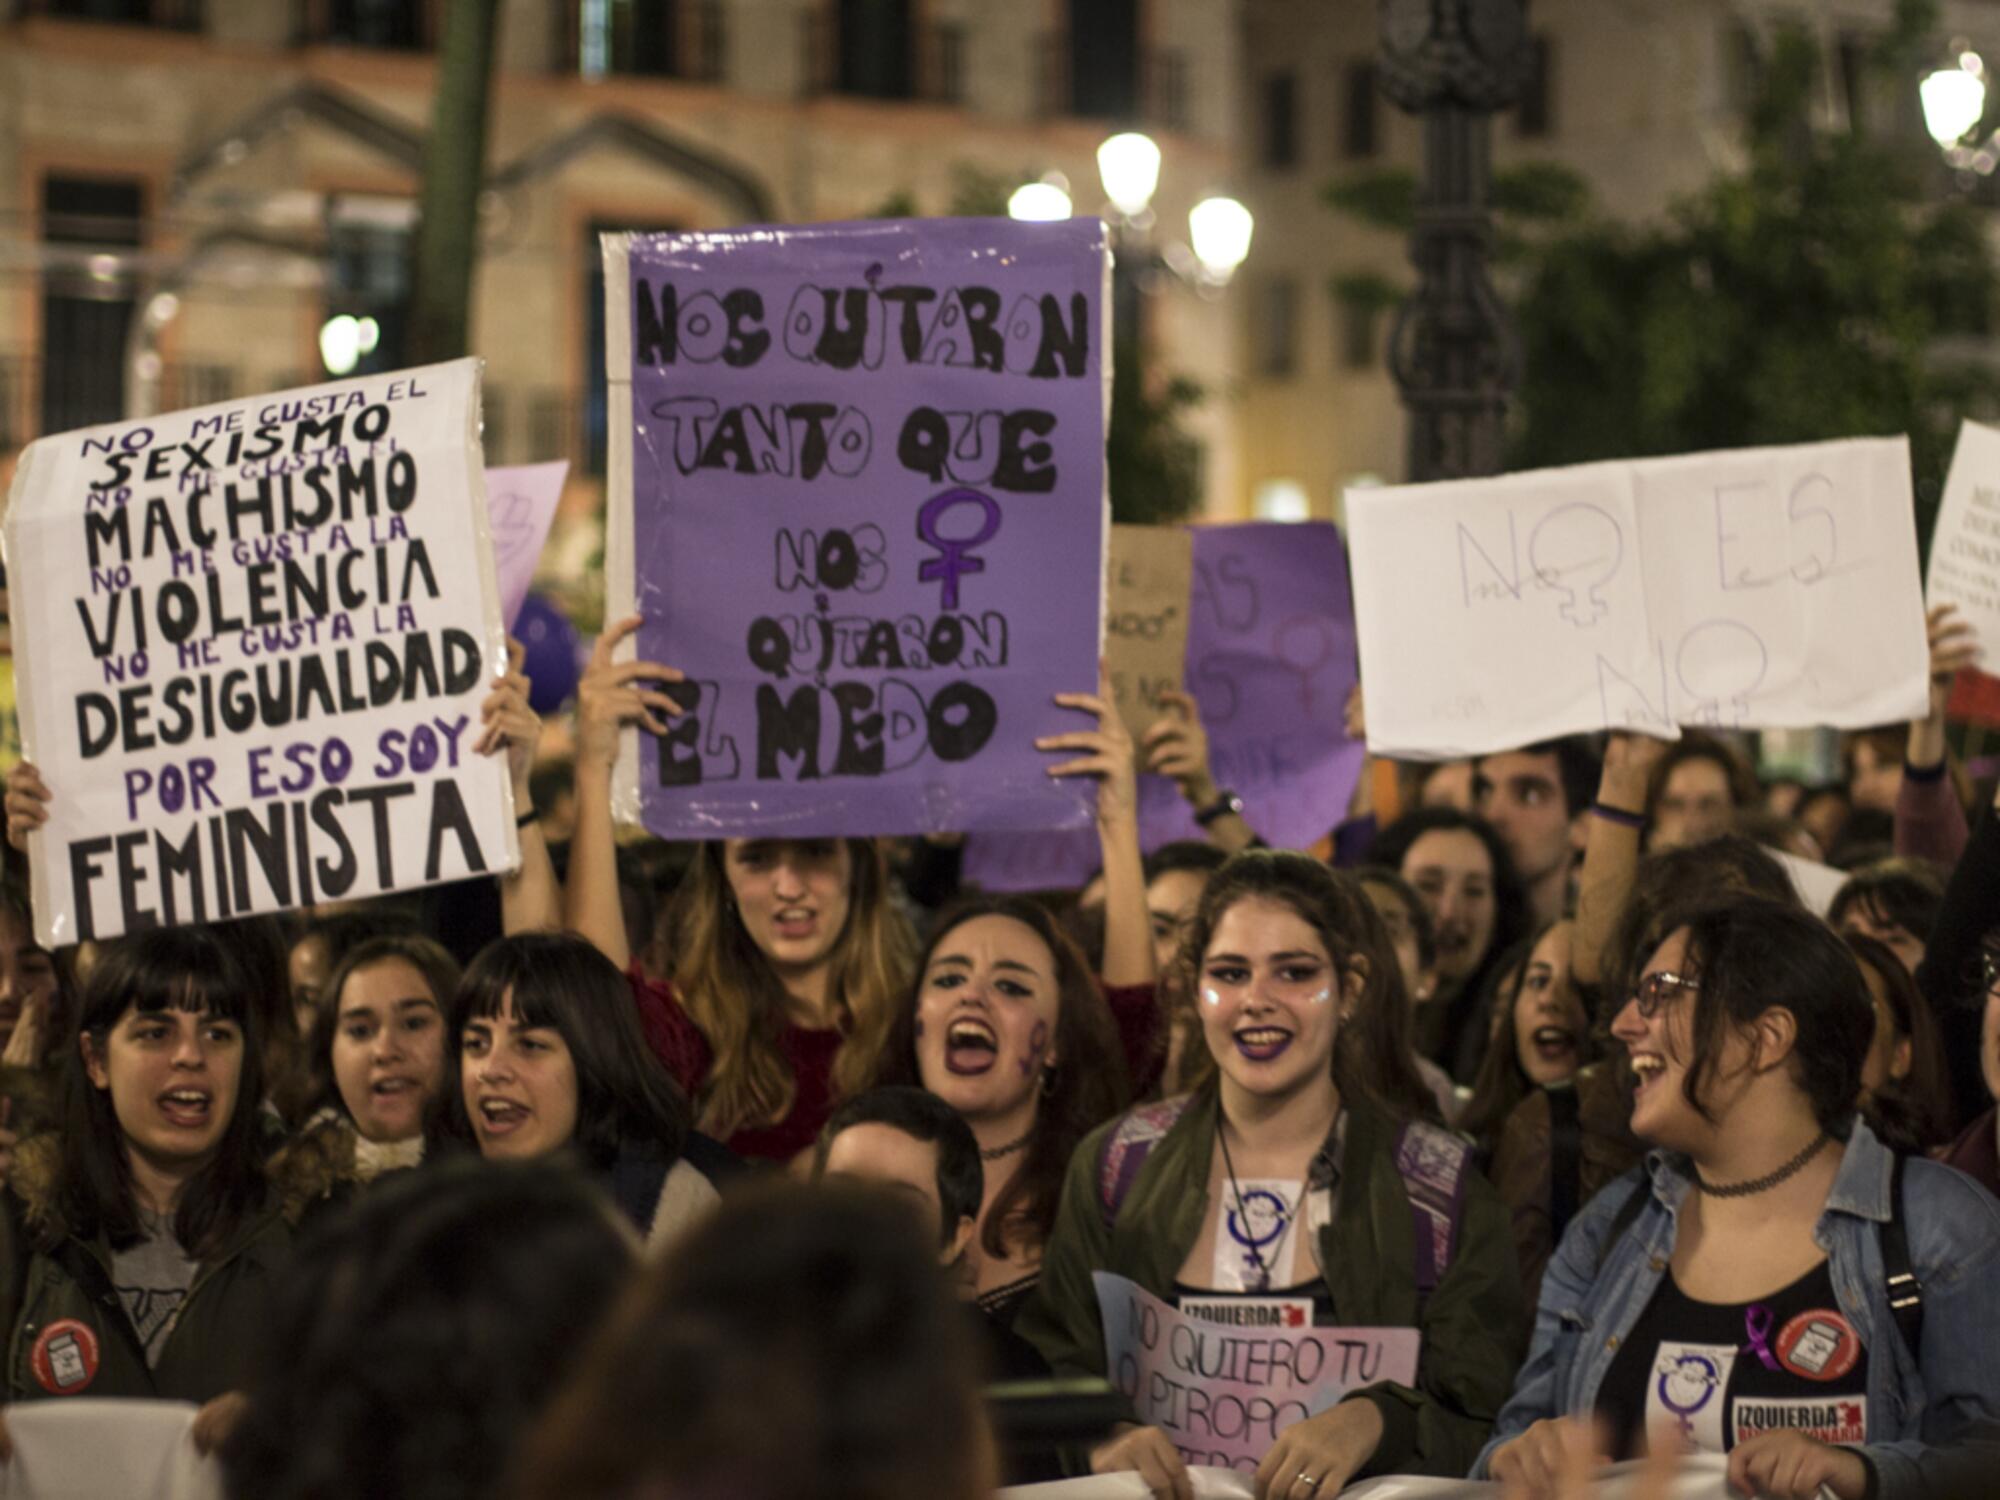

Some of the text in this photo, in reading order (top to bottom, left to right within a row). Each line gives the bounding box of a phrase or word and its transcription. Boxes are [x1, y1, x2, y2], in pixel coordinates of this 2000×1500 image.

[637, 262, 1089, 379] NOS QUITARON
[81, 378, 427, 458] NO ME GUSTA EL
[90, 403, 391, 491] SEXISMO
[651, 397, 1057, 494] TANTO QUE
[85, 437, 398, 512] NO ME GUSTA EL
[85, 450, 418, 570] MACHISMO
[91, 564, 132, 594] NO
[172, 547, 217, 578] ME
[370, 515, 410, 546] LA
[775, 522, 888, 593] NOS
[1456, 471, 1838, 626] NO ES
[76, 538, 440, 659] VIOLENCIA
[103, 603, 417, 684] NO ME GUSTA LA
[747, 594, 1009, 680] QUITARON
[75, 627, 483, 759] DESIGUALDAD
[656, 673, 998, 787] EL MIEDO
[124, 714, 470, 821] POR ESO SOY
[68, 778, 488, 944] FEMINISTA
[1128, 1295, 1384, 1388] NO QUIERO TU
[1737, 1404, 1838, 1429] IZQUIERDA
